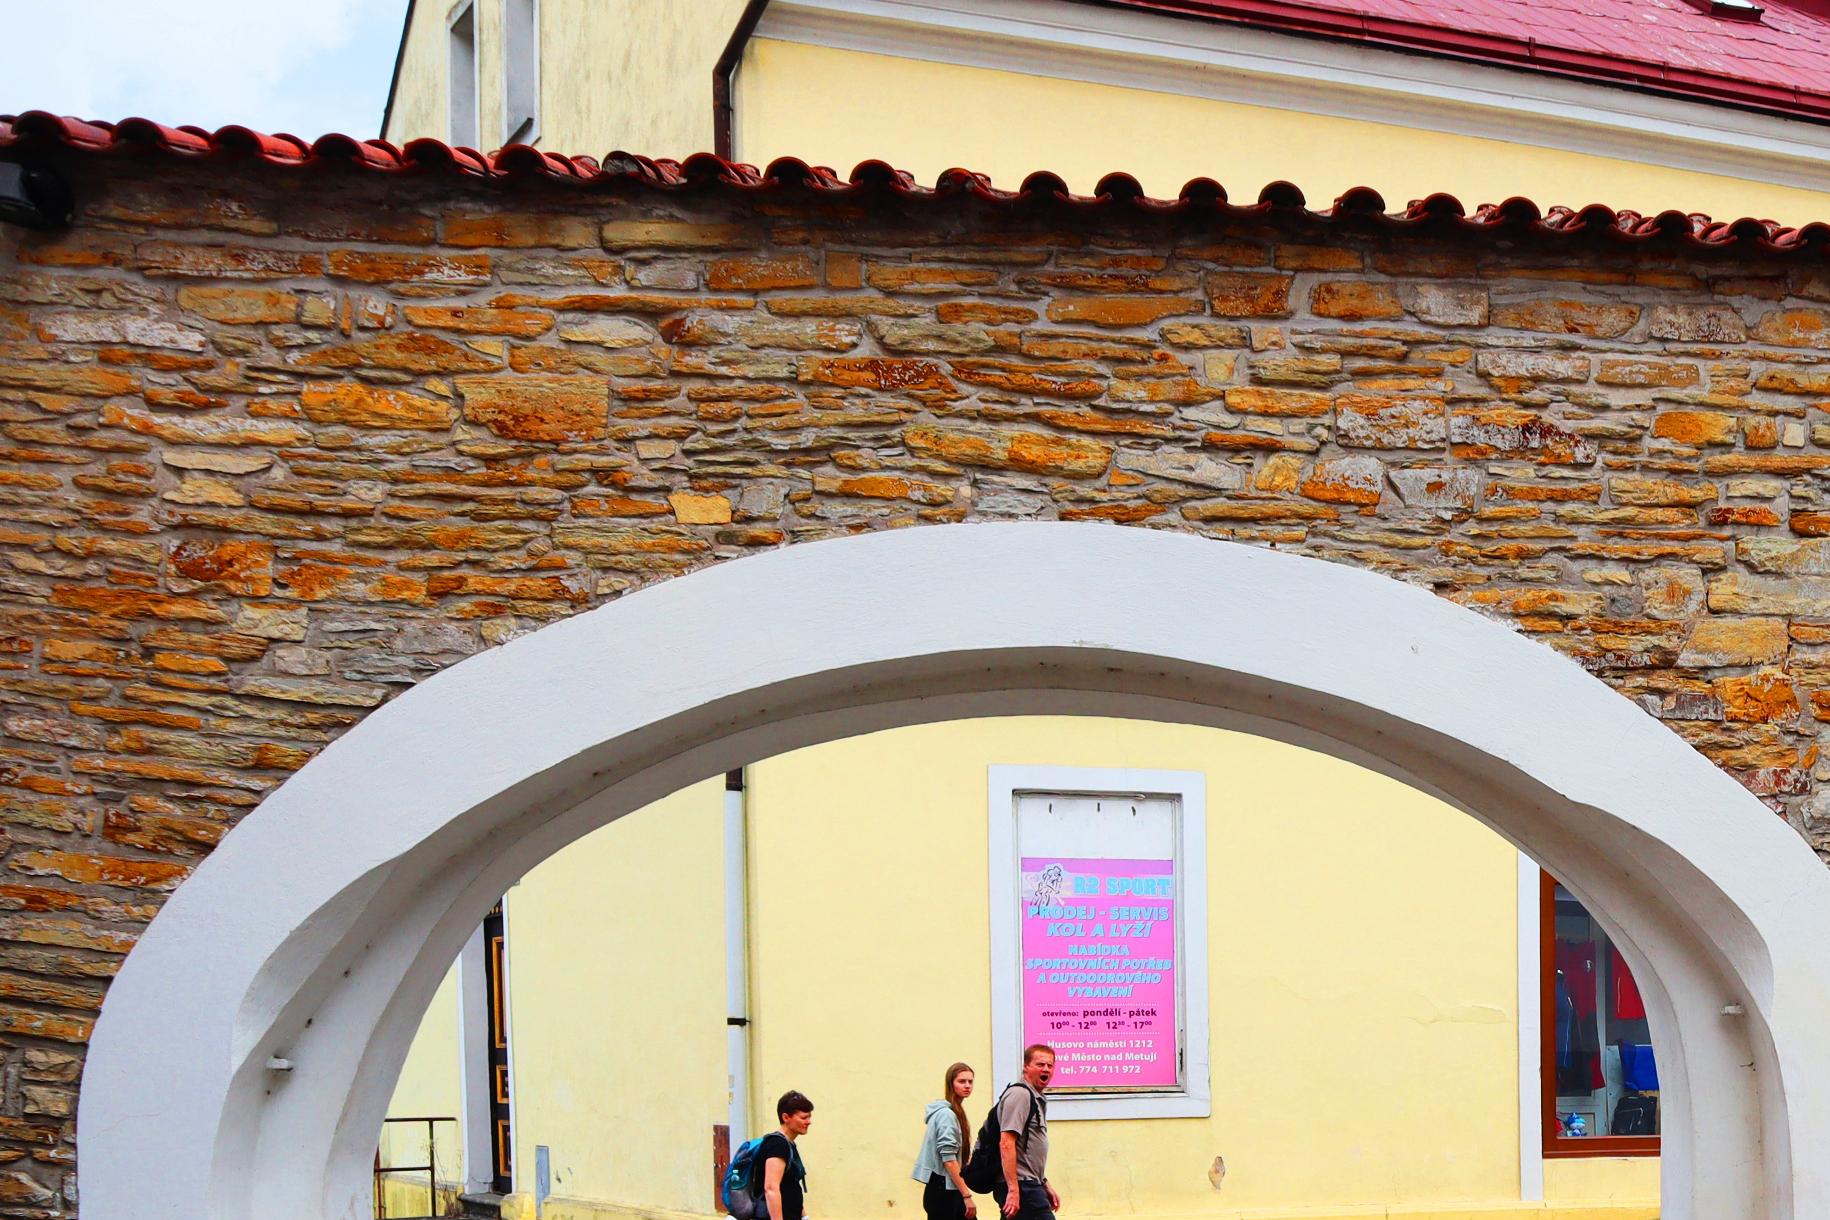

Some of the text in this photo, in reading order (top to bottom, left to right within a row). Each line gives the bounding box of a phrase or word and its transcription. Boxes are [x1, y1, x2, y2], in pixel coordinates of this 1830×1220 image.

[1074, 877, 1169, 896] R2 SPORT
[1028, 905, 1096, 920] PRODEJ
[1110, 907, 1169, 921] SERVIS
[1047, 921, 1153, 937] KOL A LYŽÍ
[1068, 943, 1130, 956] NABÍDKA
[1036, 973, 1047, 984] A
[1067, 985, 1134, 998] VYBAVENÍ
[1083, 1008, 1121, 1018] pondělí
[1128, 1008, 1157, 1018] pátek
[1047, 1039, 1153, 1049] Husovo náměstí 1212
[1054, 1052, 1157, 1062] ové Město nad Metují
[1060, 1066, 1077, 1074] tel.
